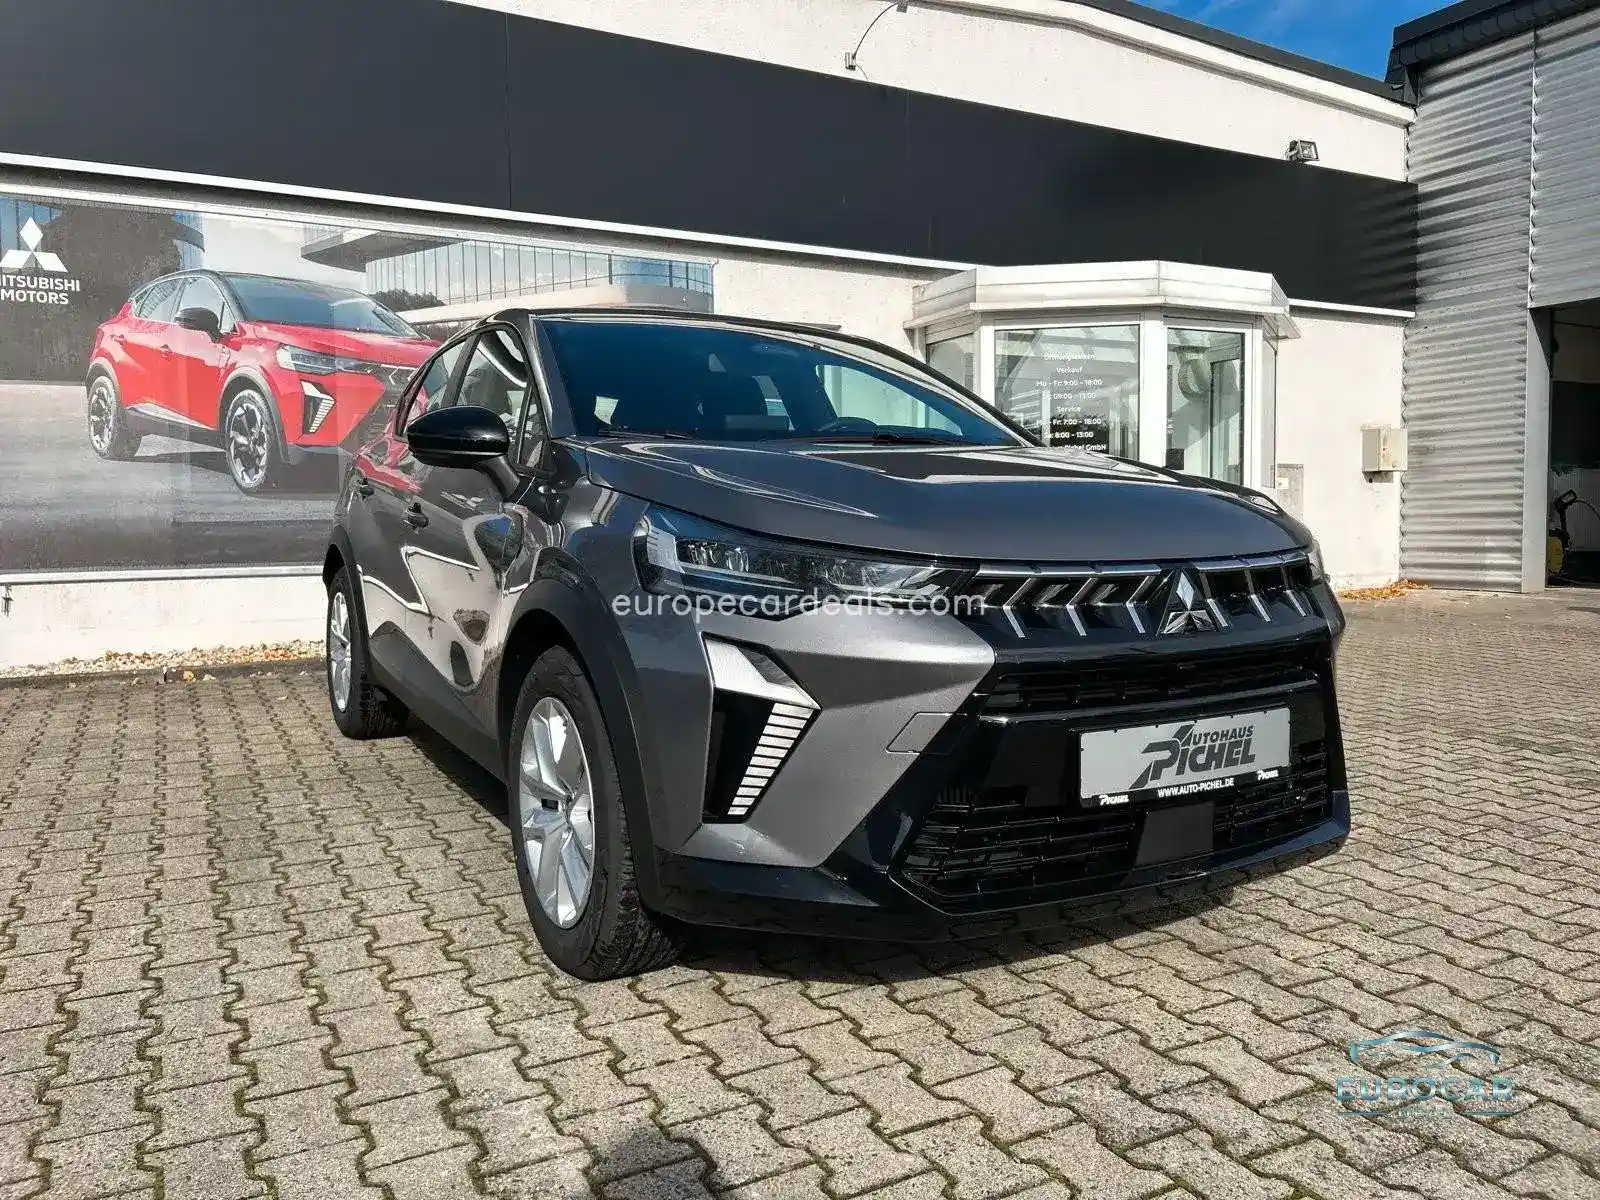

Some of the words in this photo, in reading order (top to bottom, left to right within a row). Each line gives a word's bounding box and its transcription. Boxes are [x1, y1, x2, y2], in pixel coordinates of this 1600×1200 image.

[0, 275, 80, 292] ITSUBISHI
[0, 289, 69, 305] MOTORS
[1056, 366, 1083, 374] Verkauf
[1085, 443, 1107, 451] GmbH
[1172, 723, 1254, 748] AUTOHAUS
[1129, 737, 1256, 790] PICHEL
[1157, 777, 1235, 798] WWW.AUTO-PICHEL.DE
